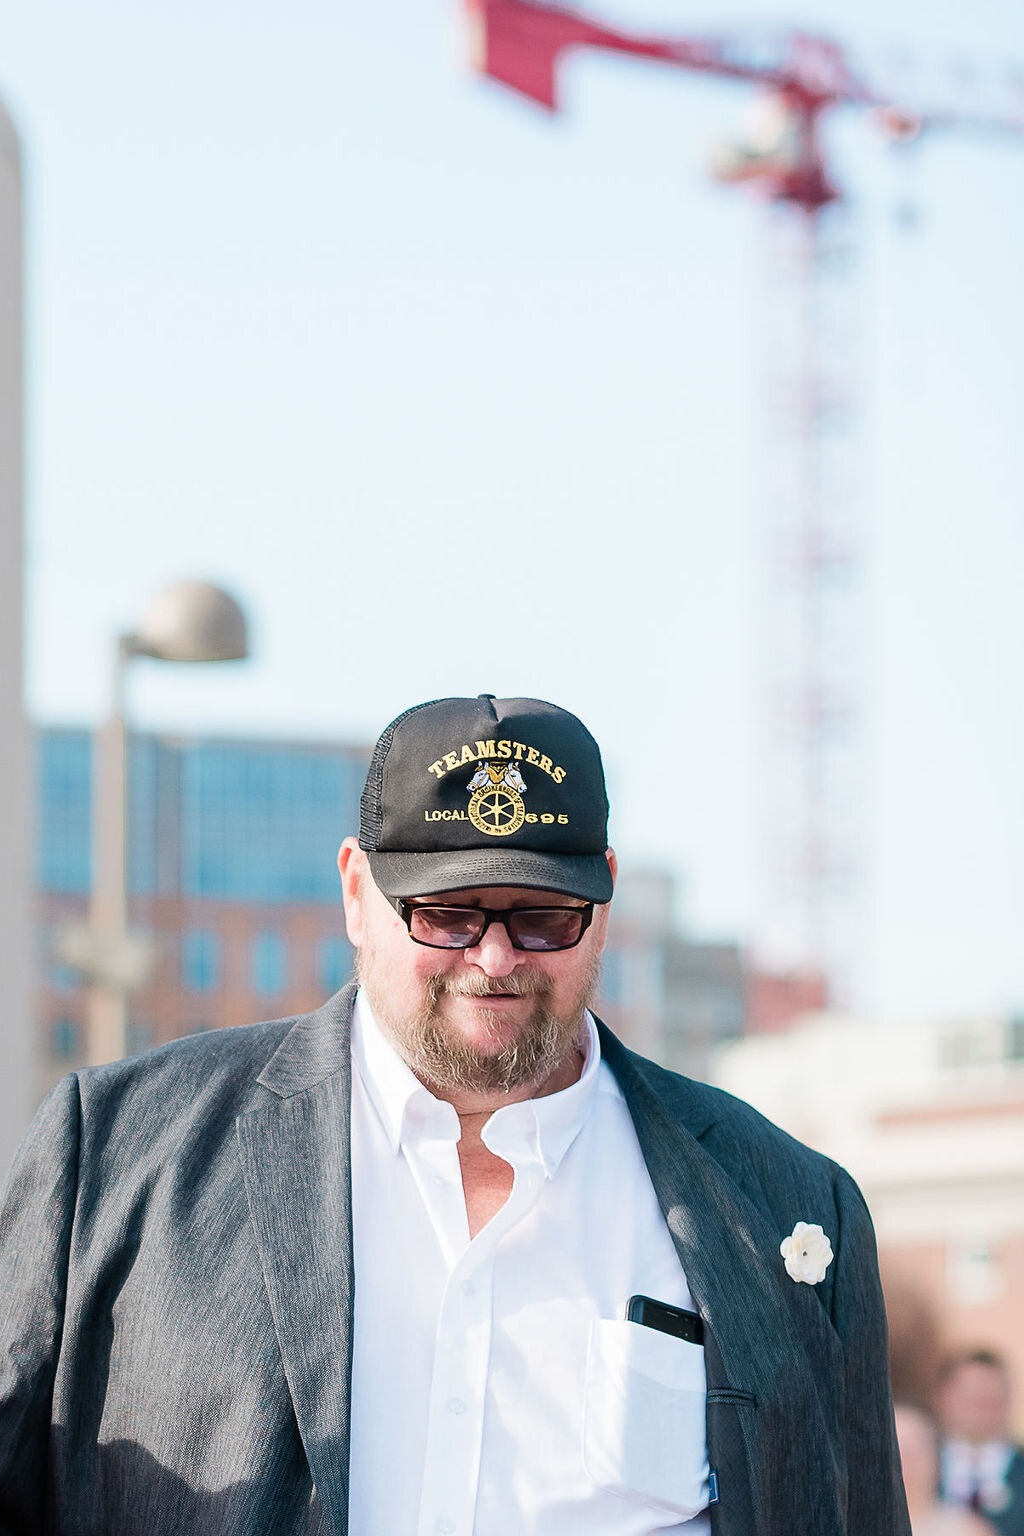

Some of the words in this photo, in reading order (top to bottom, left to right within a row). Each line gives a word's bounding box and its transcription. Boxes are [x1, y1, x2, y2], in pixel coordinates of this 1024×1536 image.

[427, 739, 567, 784] TEAMSTERS
[425, 810, 469, 822] LOCAL
[525, 813, 569, 825] 695
